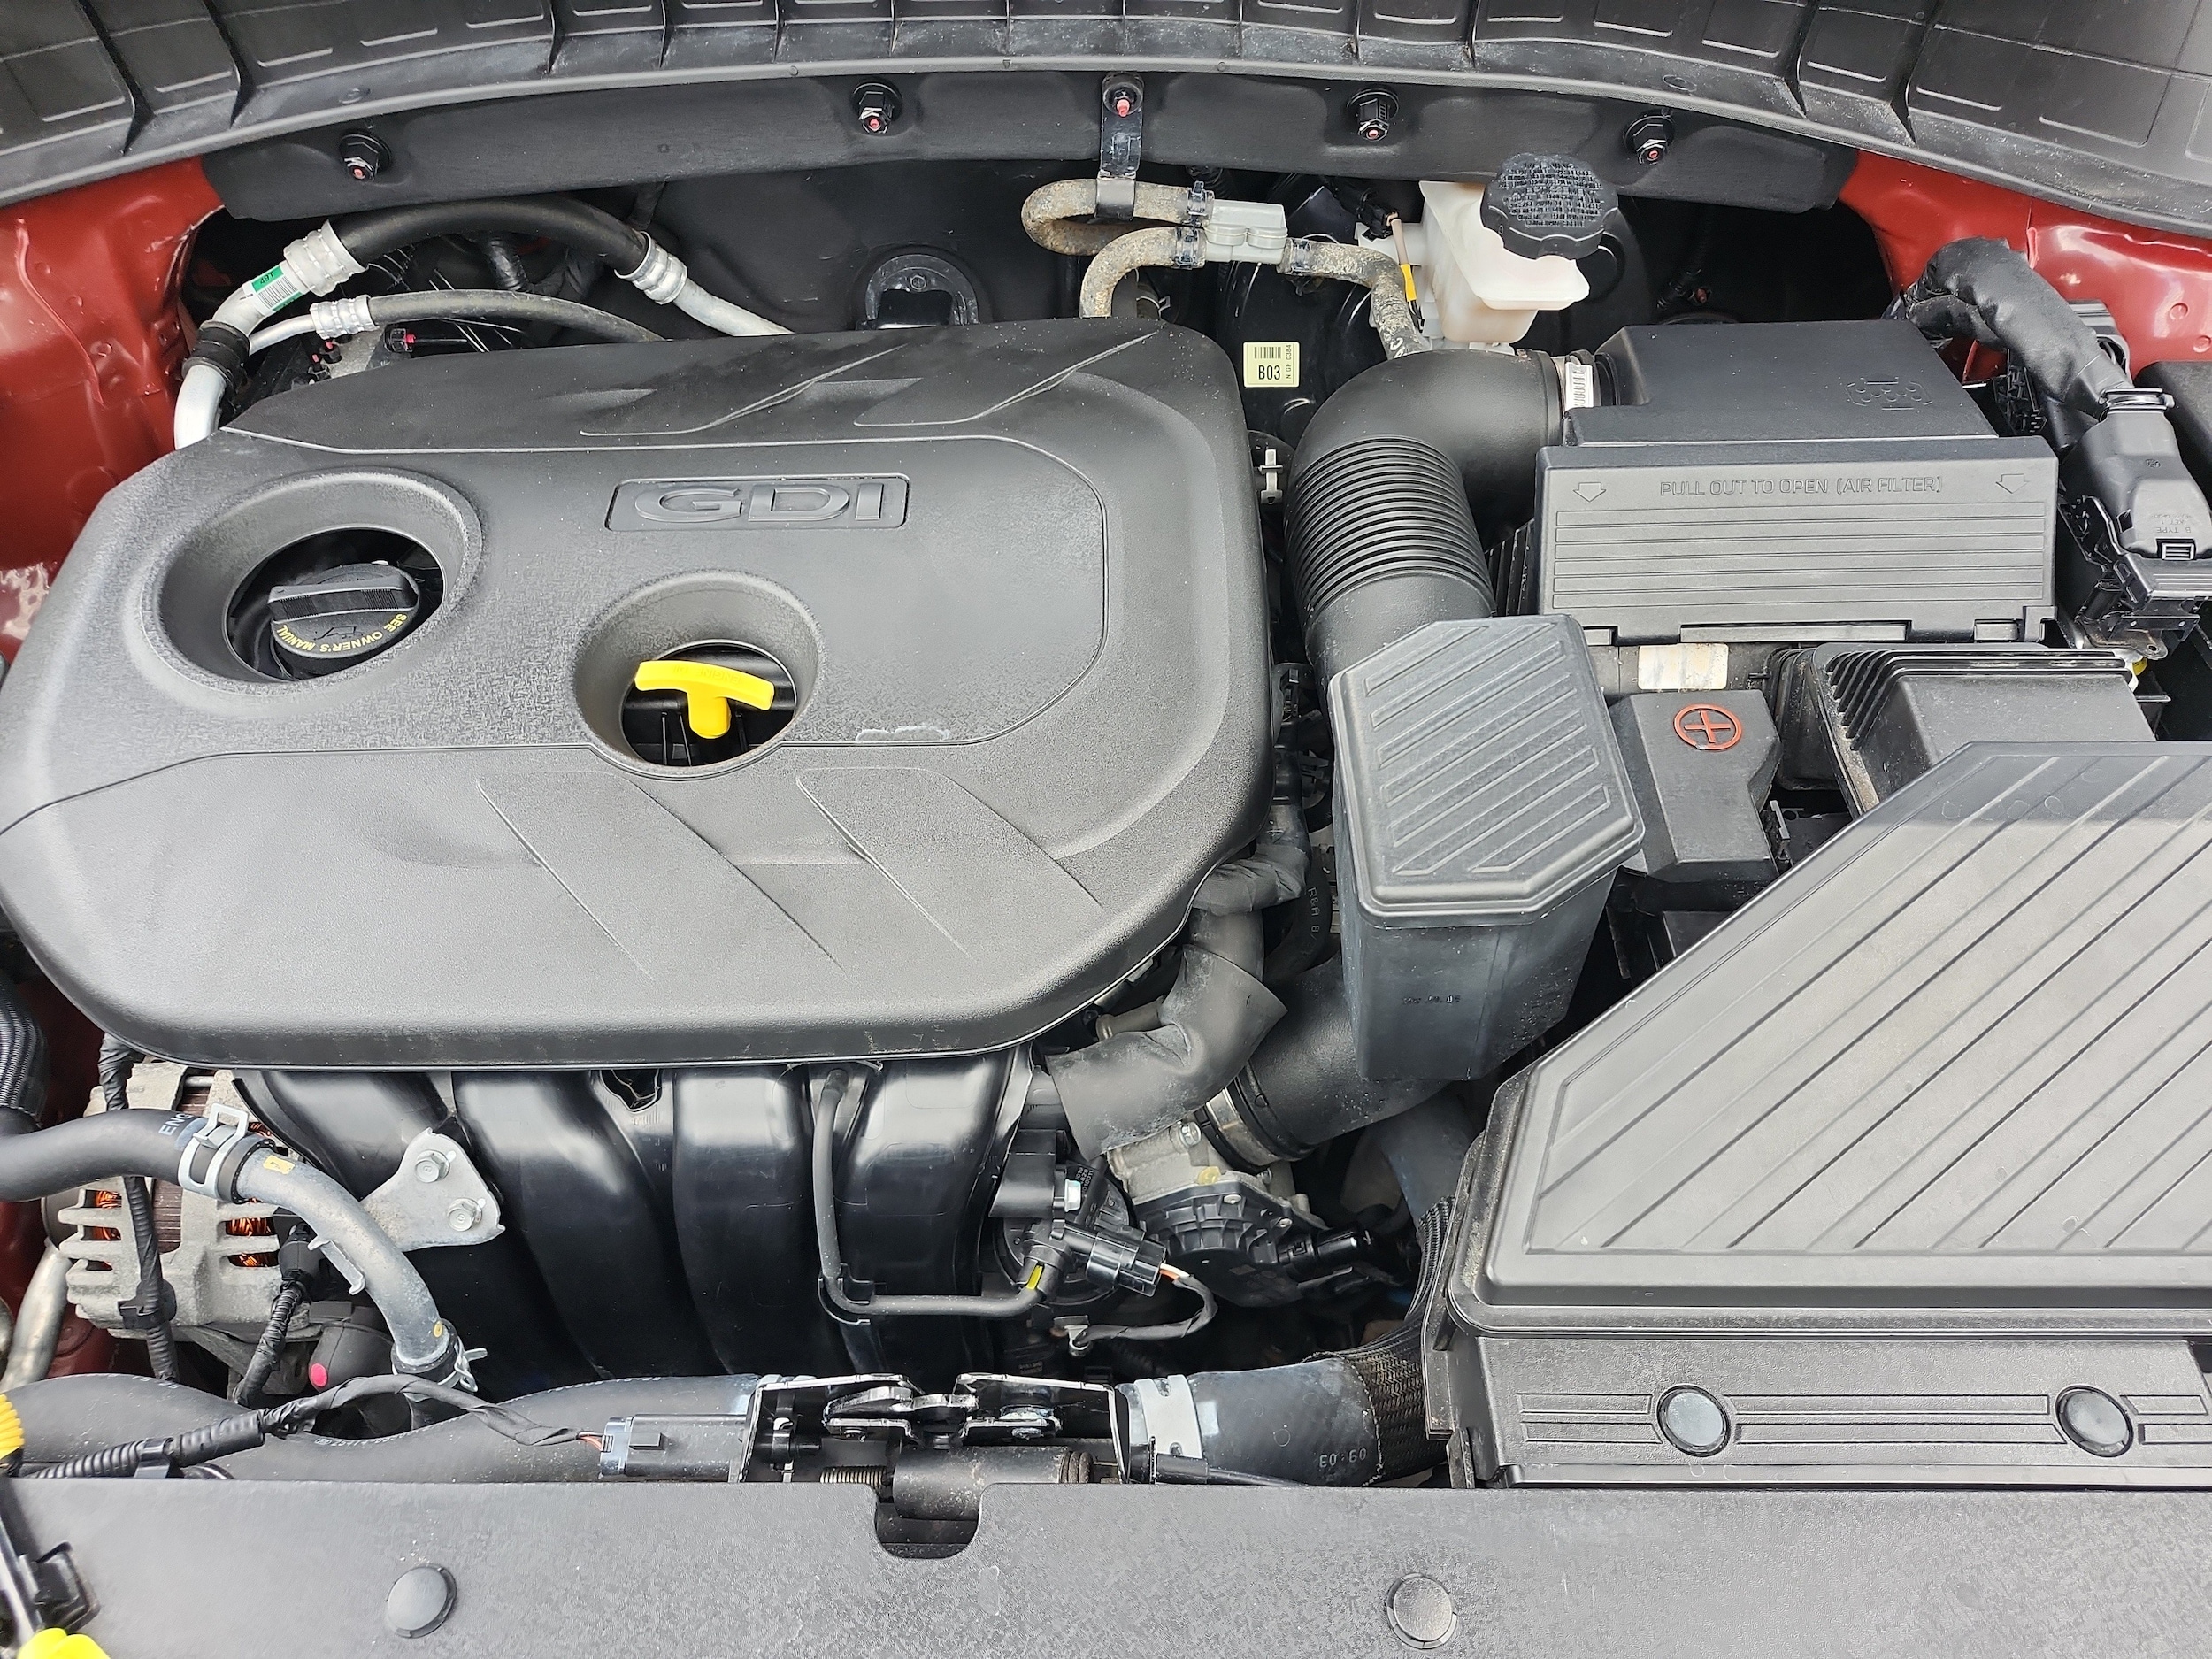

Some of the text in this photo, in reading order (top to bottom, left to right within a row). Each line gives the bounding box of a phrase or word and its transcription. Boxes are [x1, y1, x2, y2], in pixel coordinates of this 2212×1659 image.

[259, 271, 274, 285] 49T
[1258, 365, 1281, 380] B03
[1660, 475, 1943, 496] PULL OUT TO OPEN (AIR FILTER)
[634, 482, 886, 523] GDI
[276, 613, 407, 653] SEE OWNER'S MANUAL
[695, 667, 741, 684] ENGINE
